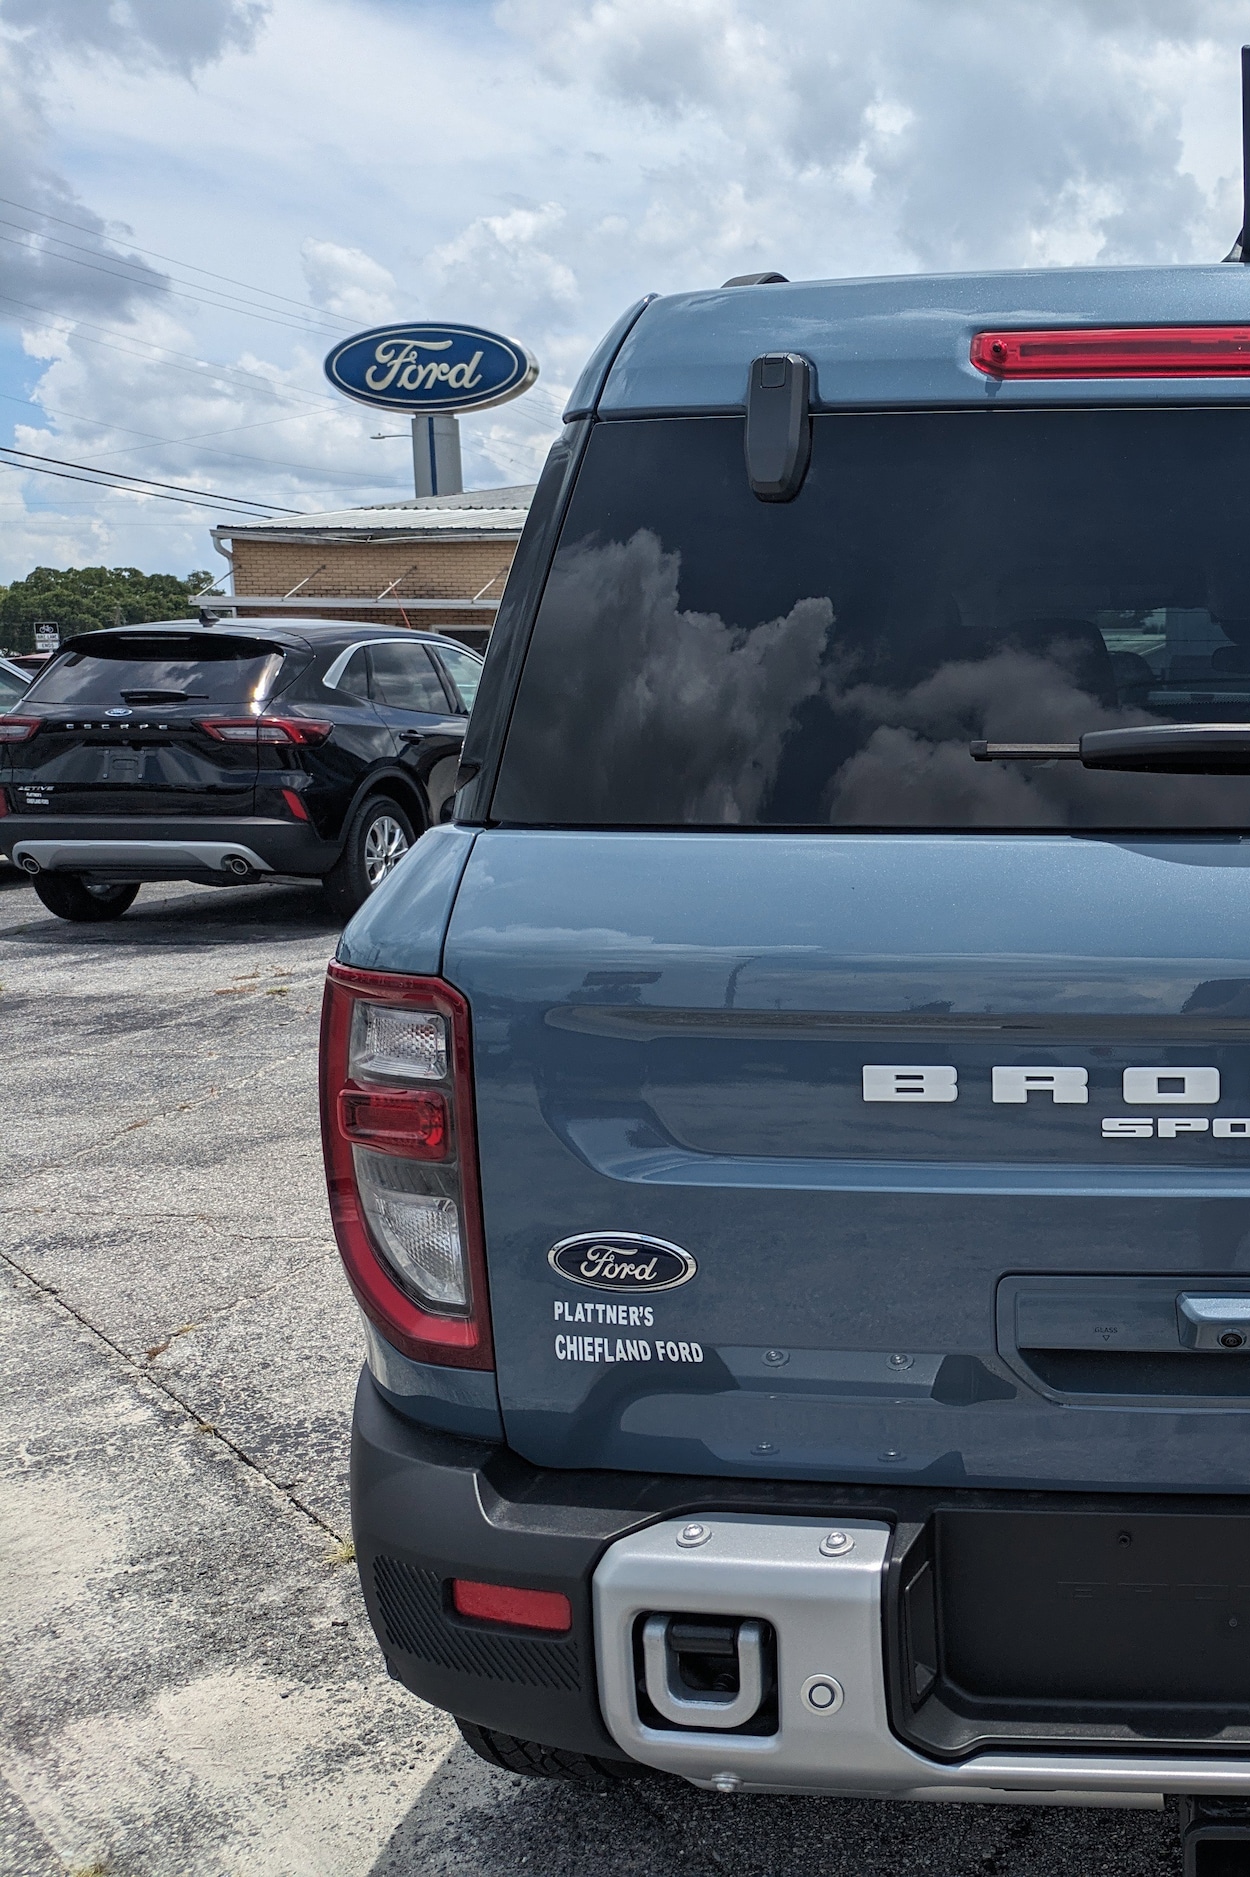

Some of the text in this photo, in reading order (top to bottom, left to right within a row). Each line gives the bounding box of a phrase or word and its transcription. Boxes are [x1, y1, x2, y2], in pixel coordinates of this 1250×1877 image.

[365, 339, 484, 391] Ford
[580, 1245, 658, 1281] Ford
[554, 1301, 654, 1327] PLATTNER'S
[555, 1334, 704, 1363] CHIEFLAND FORD
